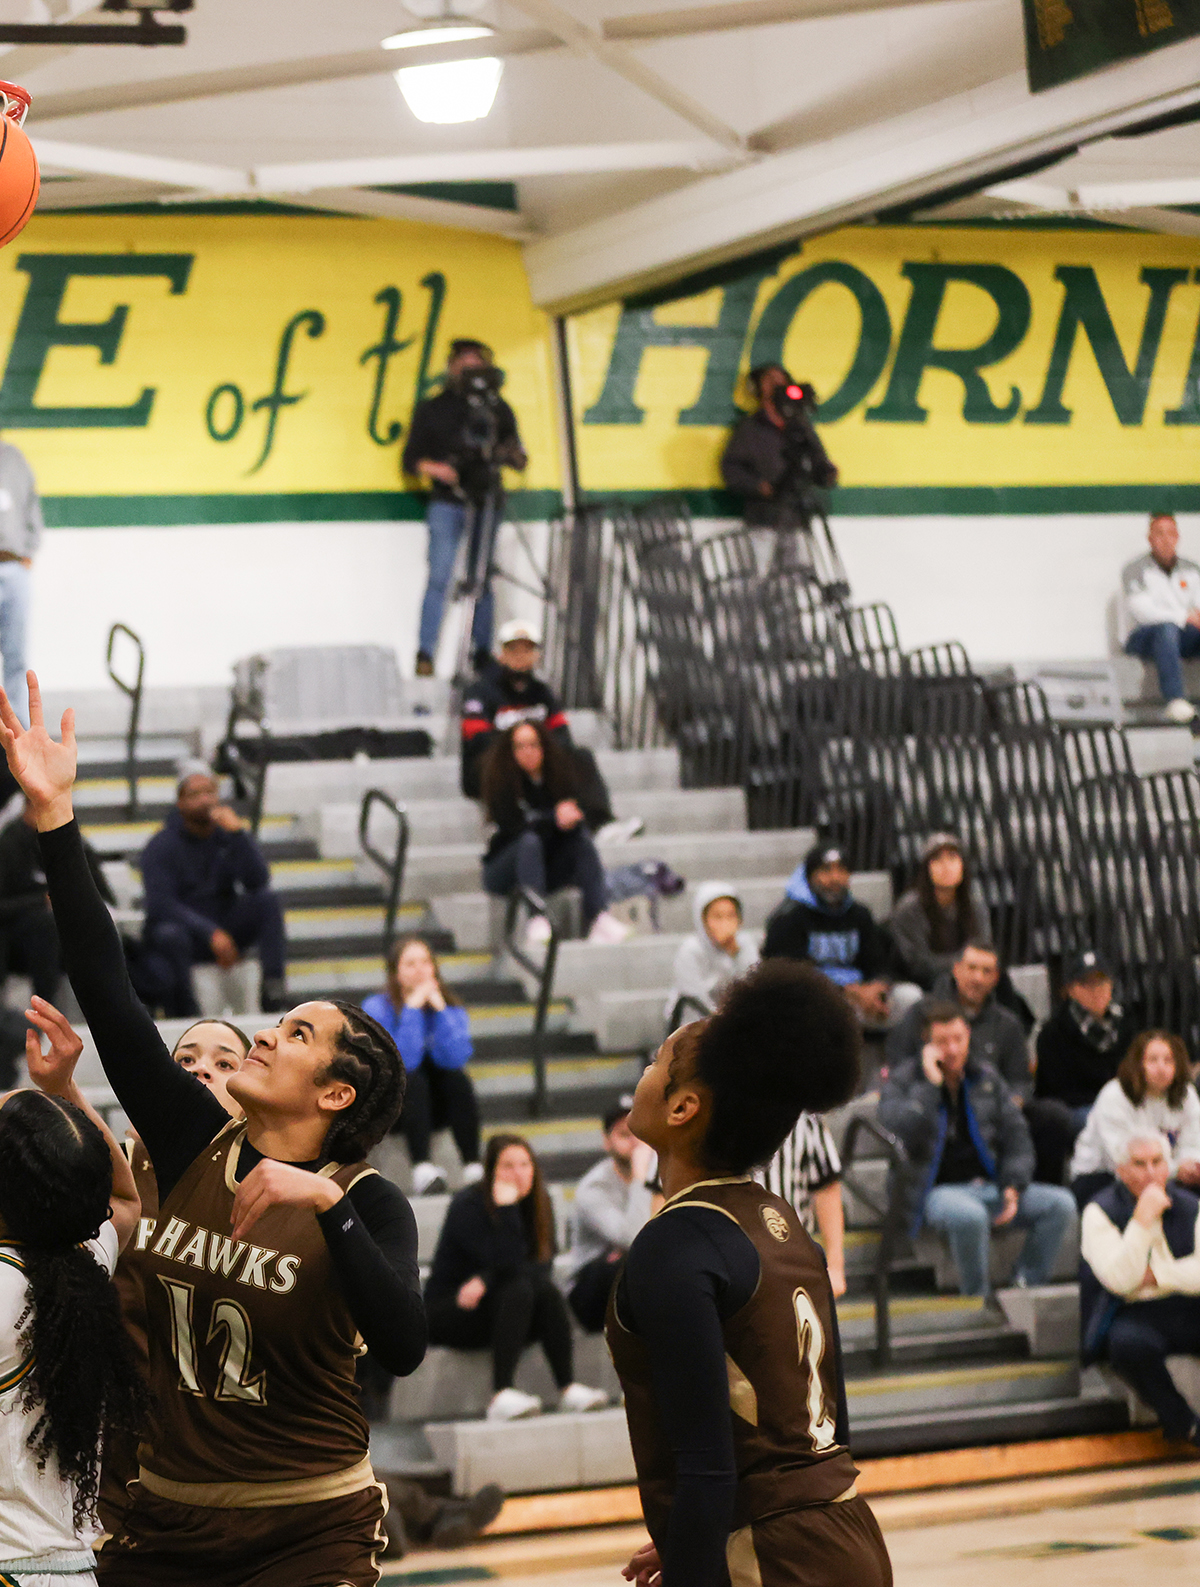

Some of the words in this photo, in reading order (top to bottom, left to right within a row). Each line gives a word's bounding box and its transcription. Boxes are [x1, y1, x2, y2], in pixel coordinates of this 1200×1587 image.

[206, 308, 327, 477] of
[360, 270, 450, 450] th
[583, 259, 1200, 427] HORN
[151, 1214, 302, 1295] HAWKS
[157, 1273, 268, 1407] 12
[792, 1286, 842, 1454] 2
